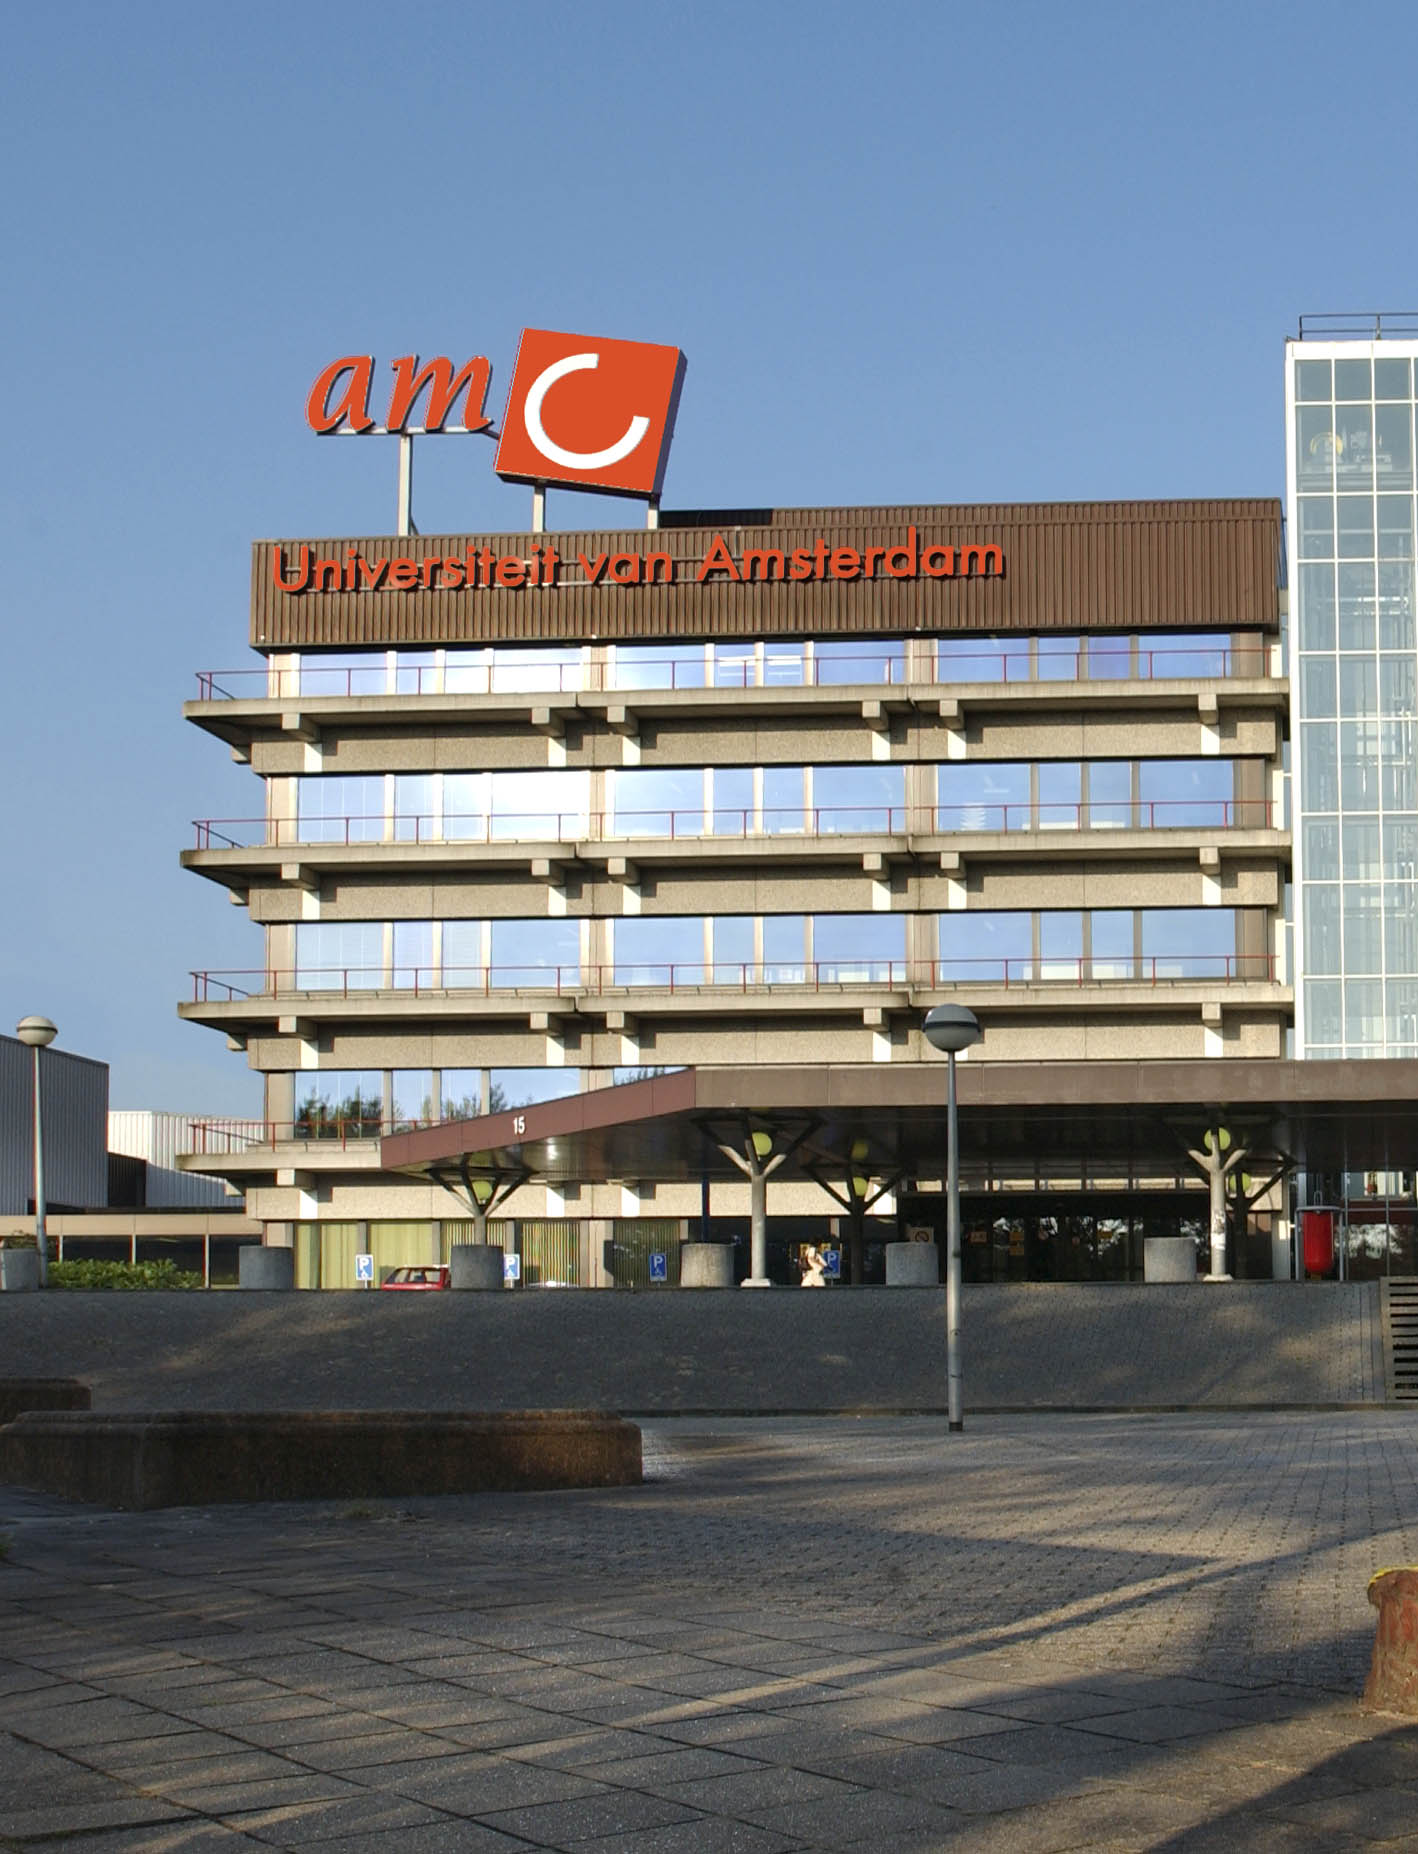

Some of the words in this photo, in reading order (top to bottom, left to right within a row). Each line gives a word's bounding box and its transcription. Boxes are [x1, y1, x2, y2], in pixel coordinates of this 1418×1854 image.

[272, 543, 560, 592] Universiteit
[577, 551, 674, 584] van
[696, 525, 1004, 581] Amsterdam
[513, 1115, 525, 1136] 15
[359, 1257, 370, 1271] P
[653, 1255, 663, 1268] P
[827, 1252, 837, 1266] P
